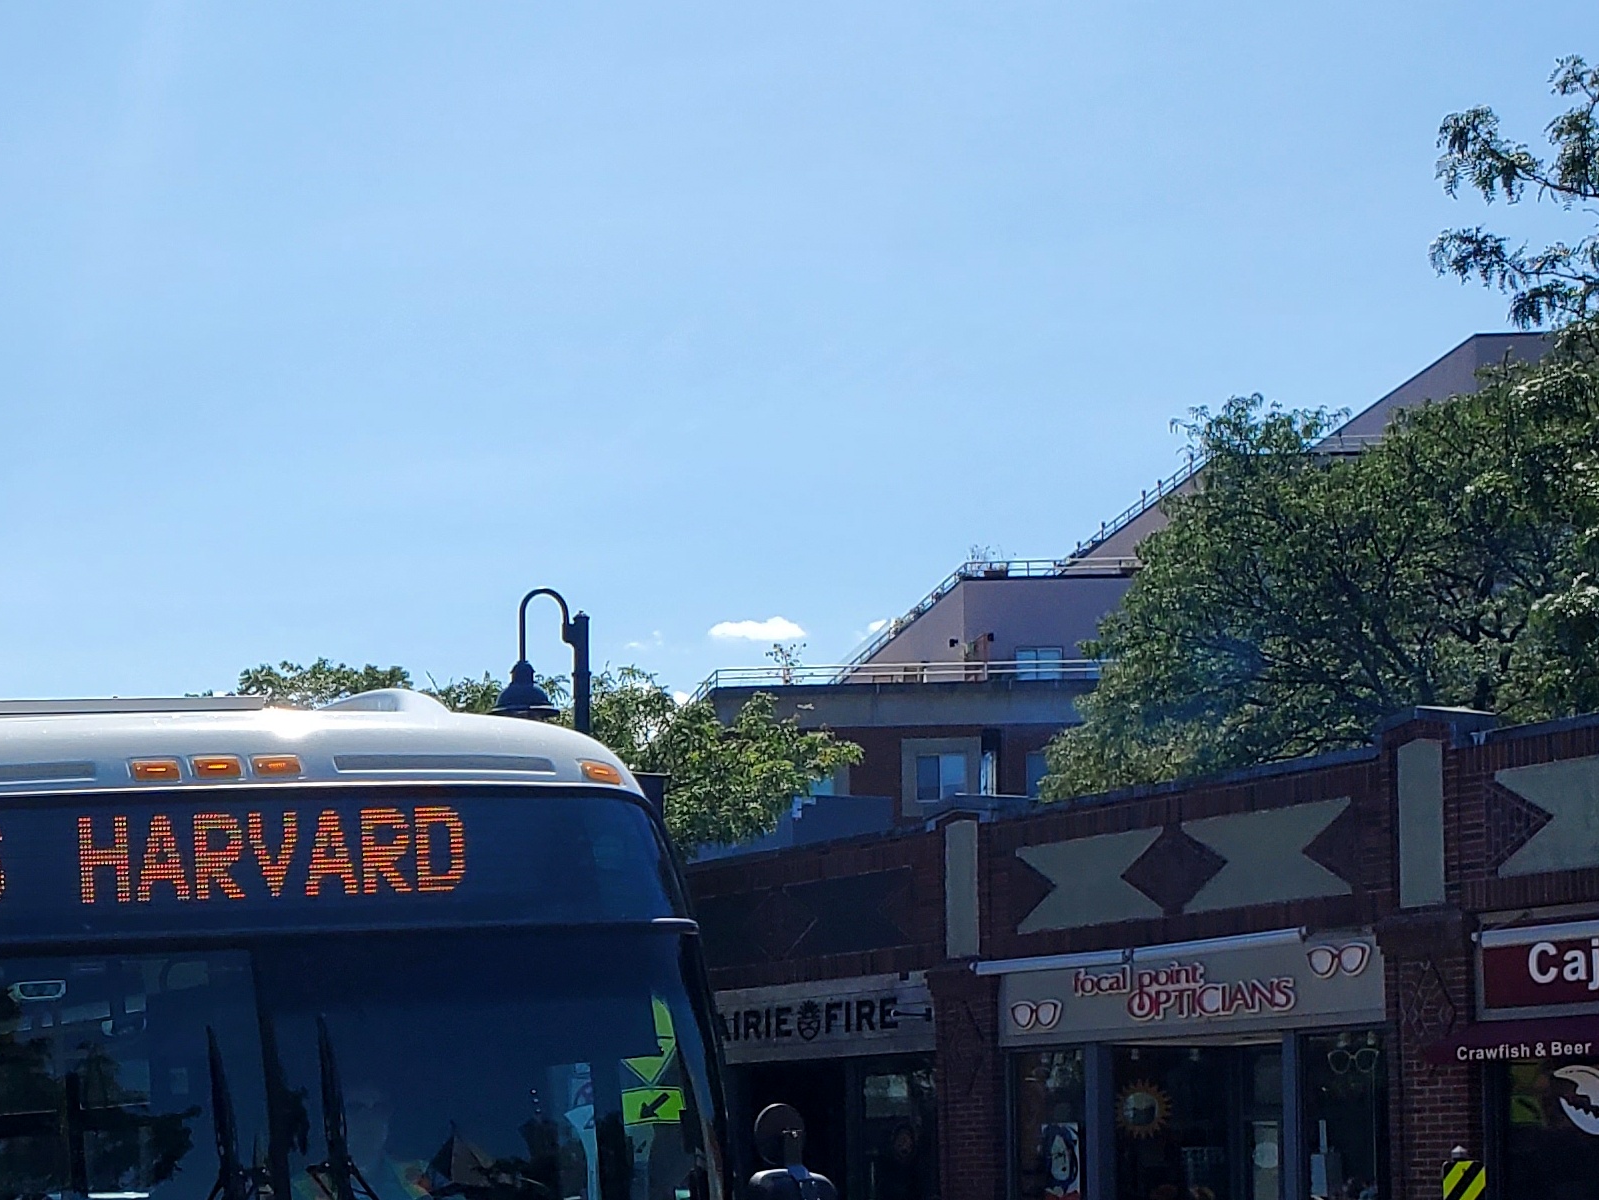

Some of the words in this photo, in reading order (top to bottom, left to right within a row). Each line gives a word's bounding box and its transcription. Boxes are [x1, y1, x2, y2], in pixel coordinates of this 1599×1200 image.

[78, 806, 465, 904] HARVARD
[1073, 965, 1131, 997] focal
[1137, 961, 1205, 1000] point
[1127, 976, 1297, 1020] OPTICIANS
[825, 998, 899, 1034] FIRE
[1457, 1043, 1531, 1061] Crawfish
[1535, 1043, 1547, 1057] &
[1551, 1041, 1592, 1056] Beer
